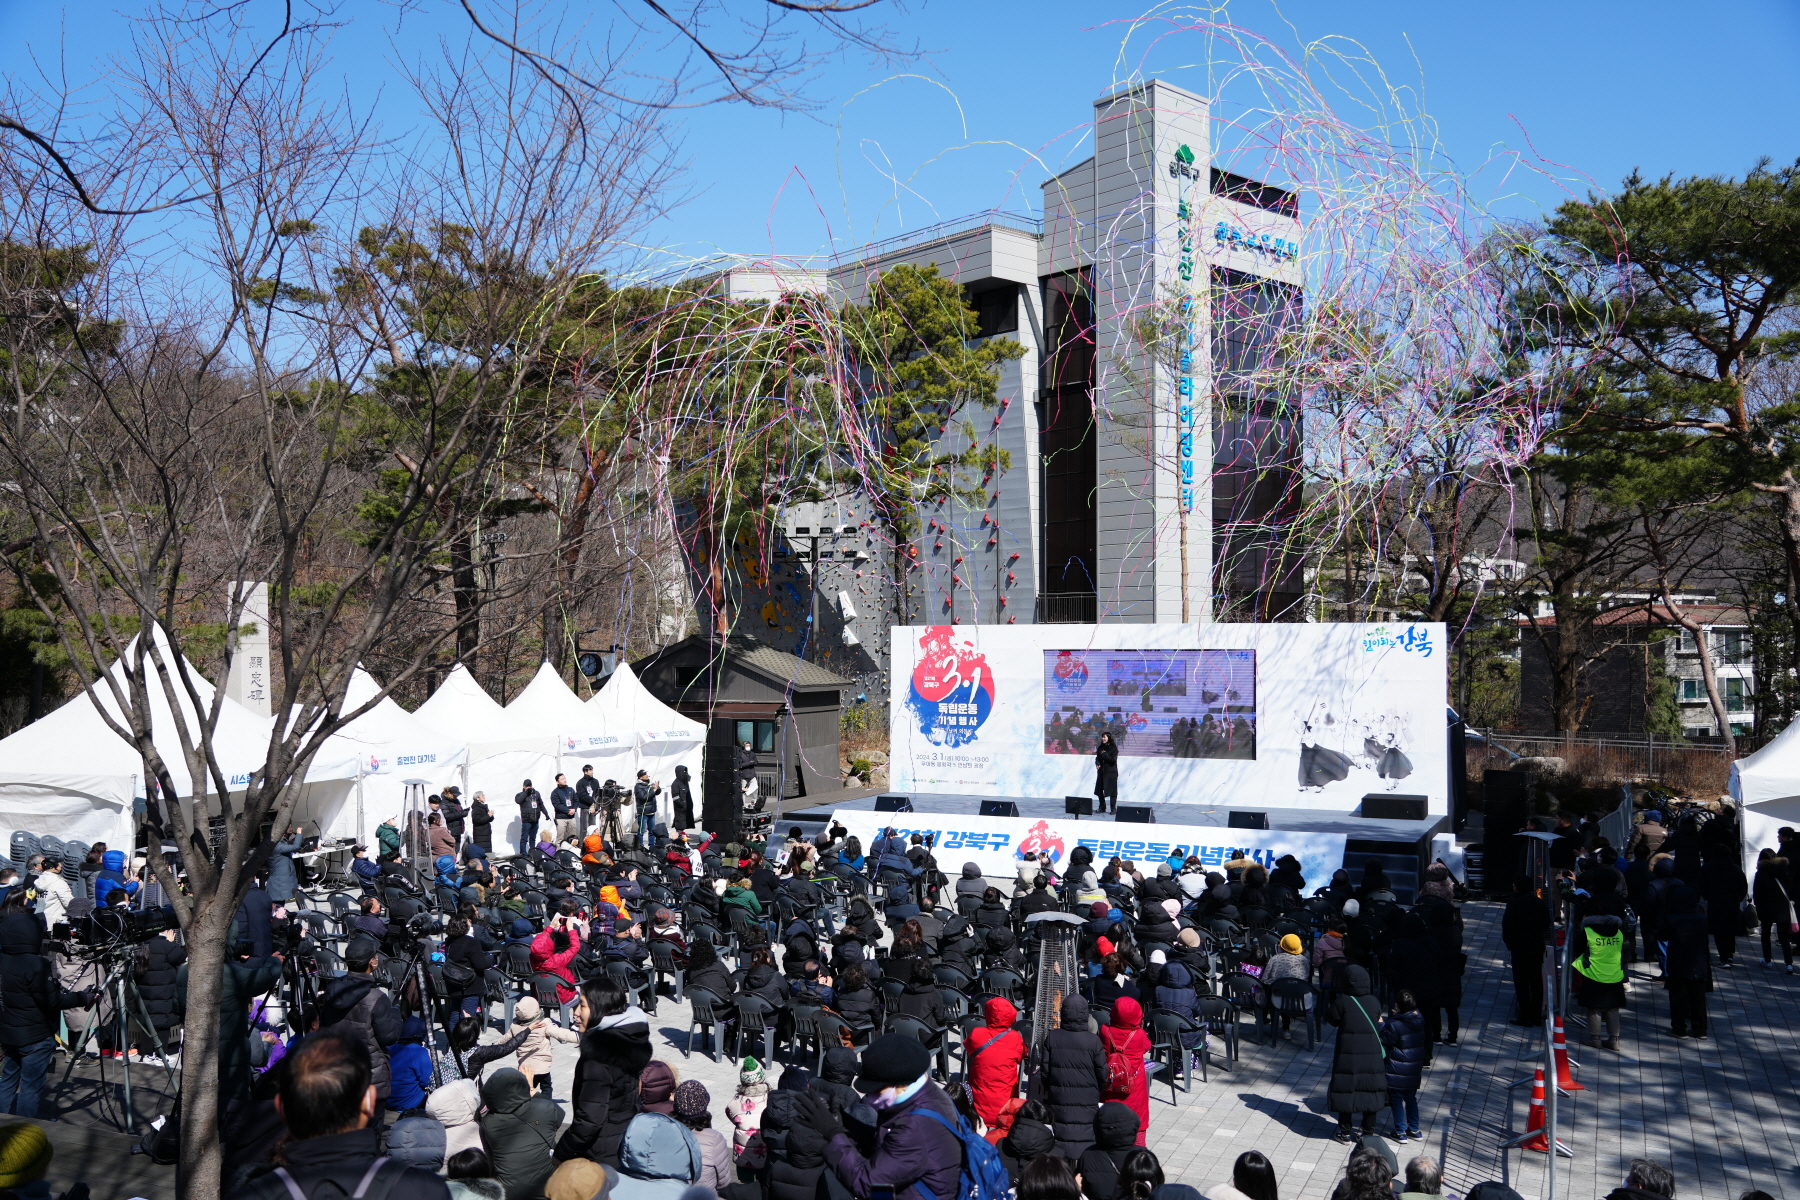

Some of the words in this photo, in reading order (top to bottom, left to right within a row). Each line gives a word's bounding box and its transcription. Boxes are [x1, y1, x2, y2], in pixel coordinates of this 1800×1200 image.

[1395, 625, 1433, 658] 강북
[936, 655, 982, 704] 3.1
[938, 703, 978, 714] 독립운동
[939, 716, 978, 726] 기념행사
[417, 754, 436, 763] 대기실
[943, 830, 1010, 851] 강북구
[1077, 838, 1170, 862] 독립운동
[1596, 937, 1620, 947] STAFF
